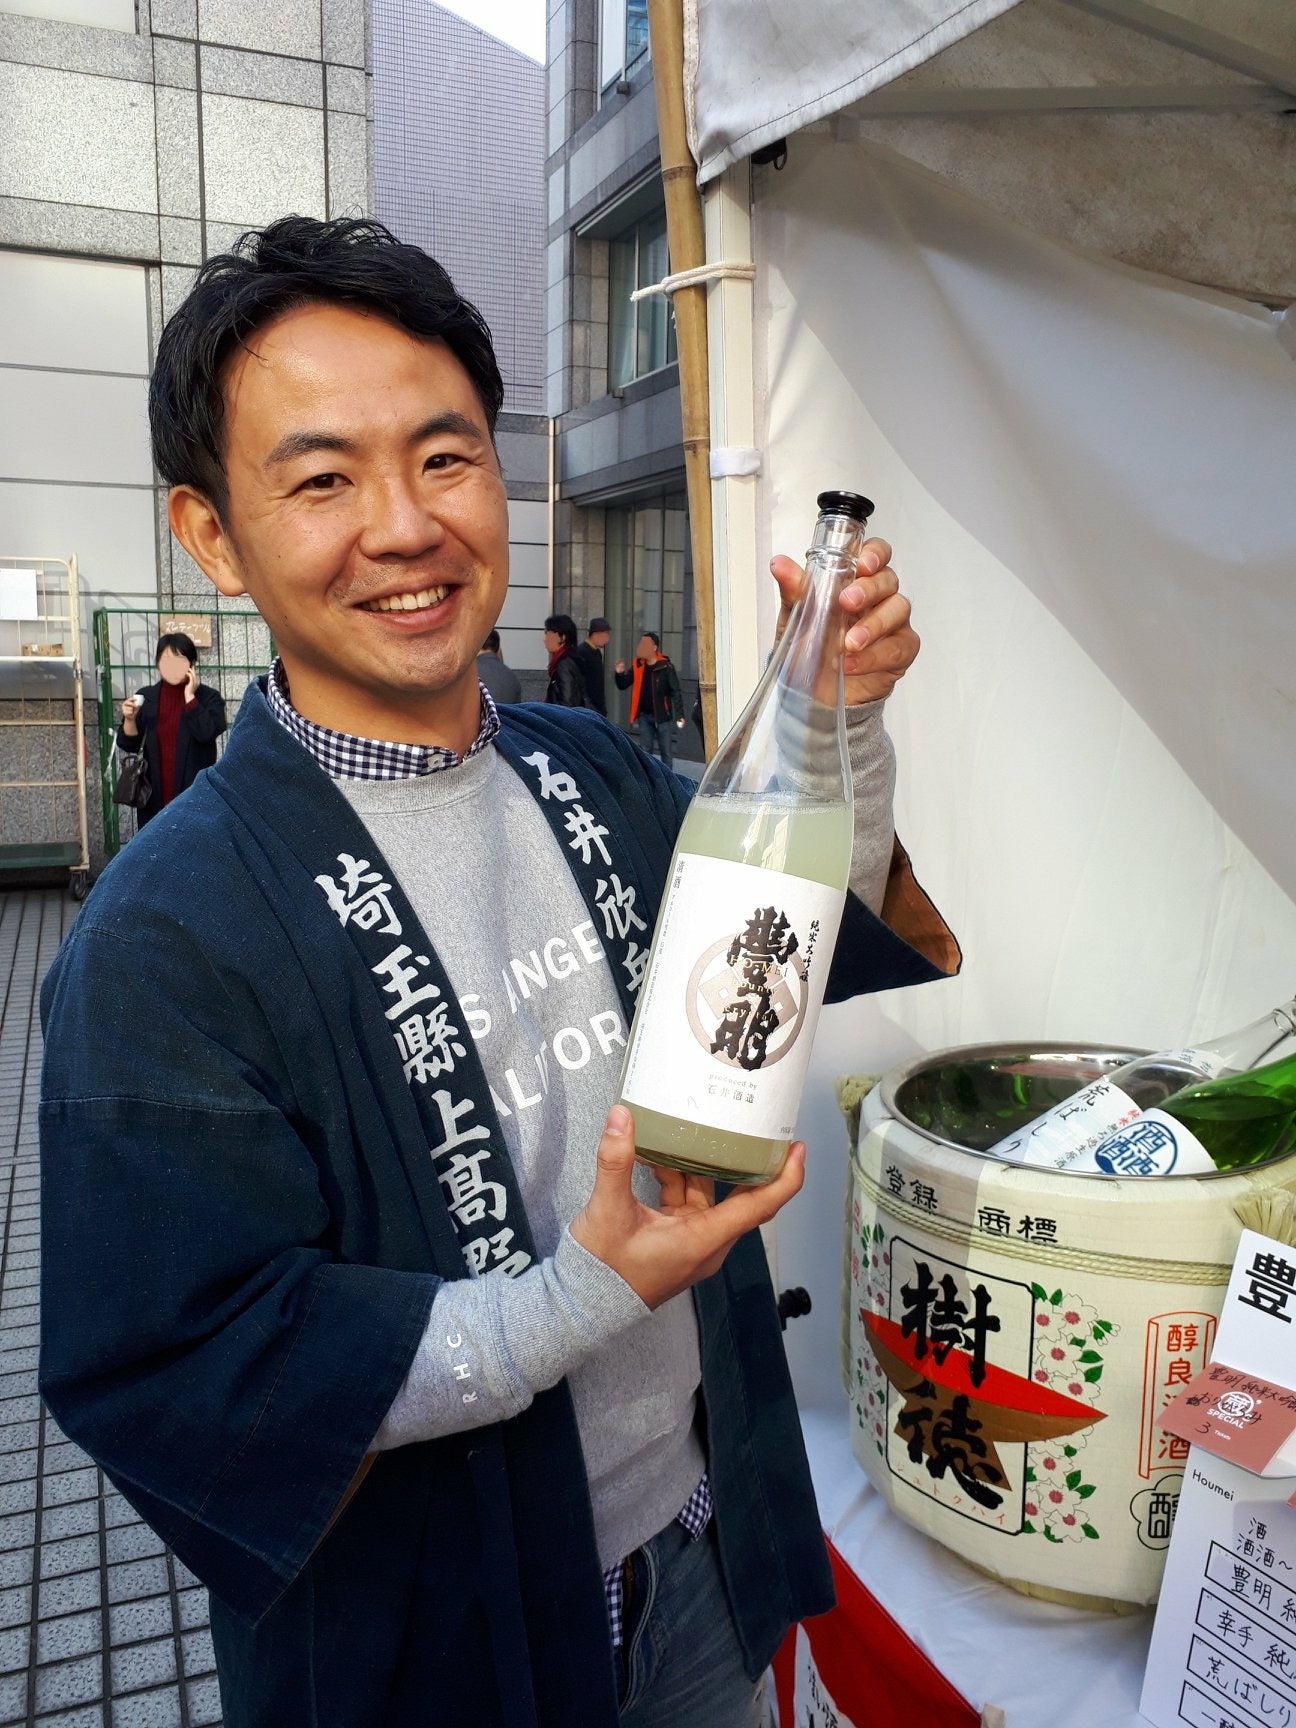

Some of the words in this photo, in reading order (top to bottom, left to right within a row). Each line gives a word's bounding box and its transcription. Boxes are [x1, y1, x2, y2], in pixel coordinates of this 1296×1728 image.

[708, 1073, 746, 1087] produced
[749, 1081, 758, 1090] by
[708, 1084, 755, 1103] 石井酒造
[1004, 1085, 1110, 1152] 荒ばしり
[1158, 1322, 1199, 1460] 醇良酒
[1195, 1421, 1212, 1434] 3
[1206, 1408, 1244, 1429] SPECIAL
[1192, 1469, 1234, 1501] Houmei
[1231, 1564, 1272, 1610] 豊明
[1217, 1609, 1254, 1648] 幸手
[1206, 1656, 1291, 1728] 荒ばしり
